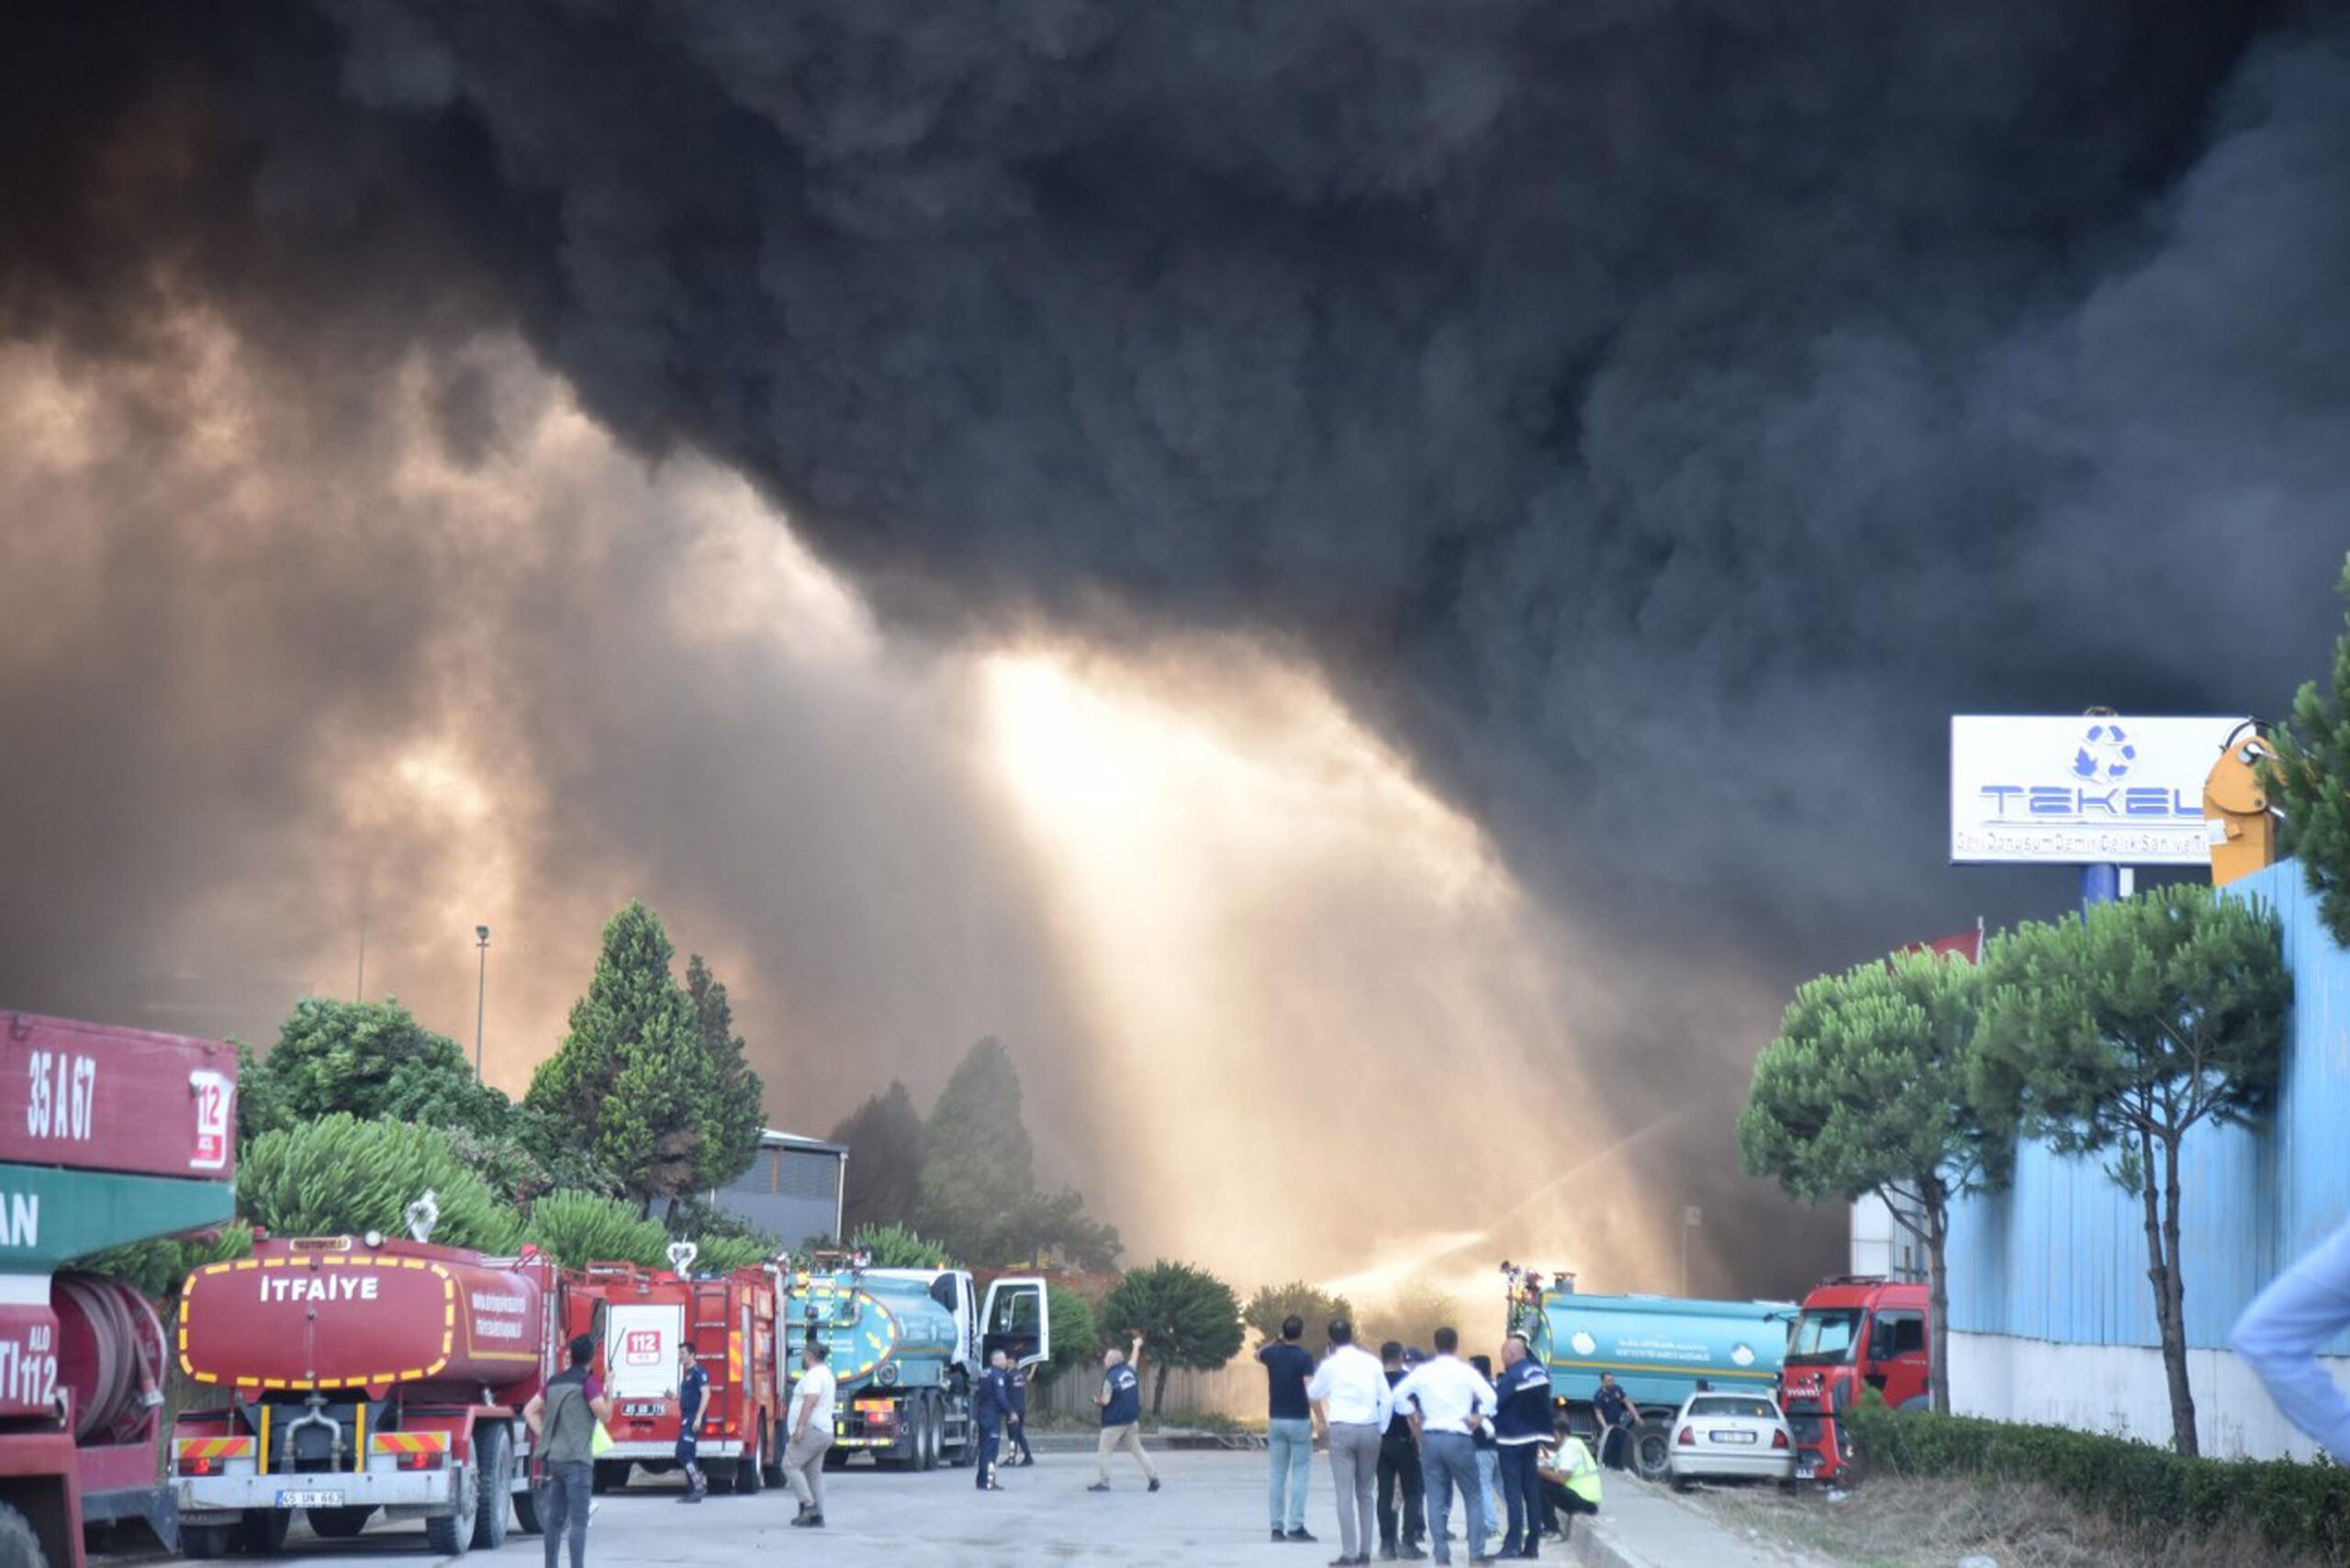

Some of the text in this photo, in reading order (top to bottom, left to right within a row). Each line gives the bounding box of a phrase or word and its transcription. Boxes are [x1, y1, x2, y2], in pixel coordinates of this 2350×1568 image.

[1980, 785, 2205, 816] TEKEL
[27, 1051, 96, 1141] 35 A 67
[260, 1273, 379, 1303] İTFAİYE
[28, 1324, 50, 1351] ALO
[631, 1334, 656, 1352] 112
[20, 1354, 57, 1406] 112
